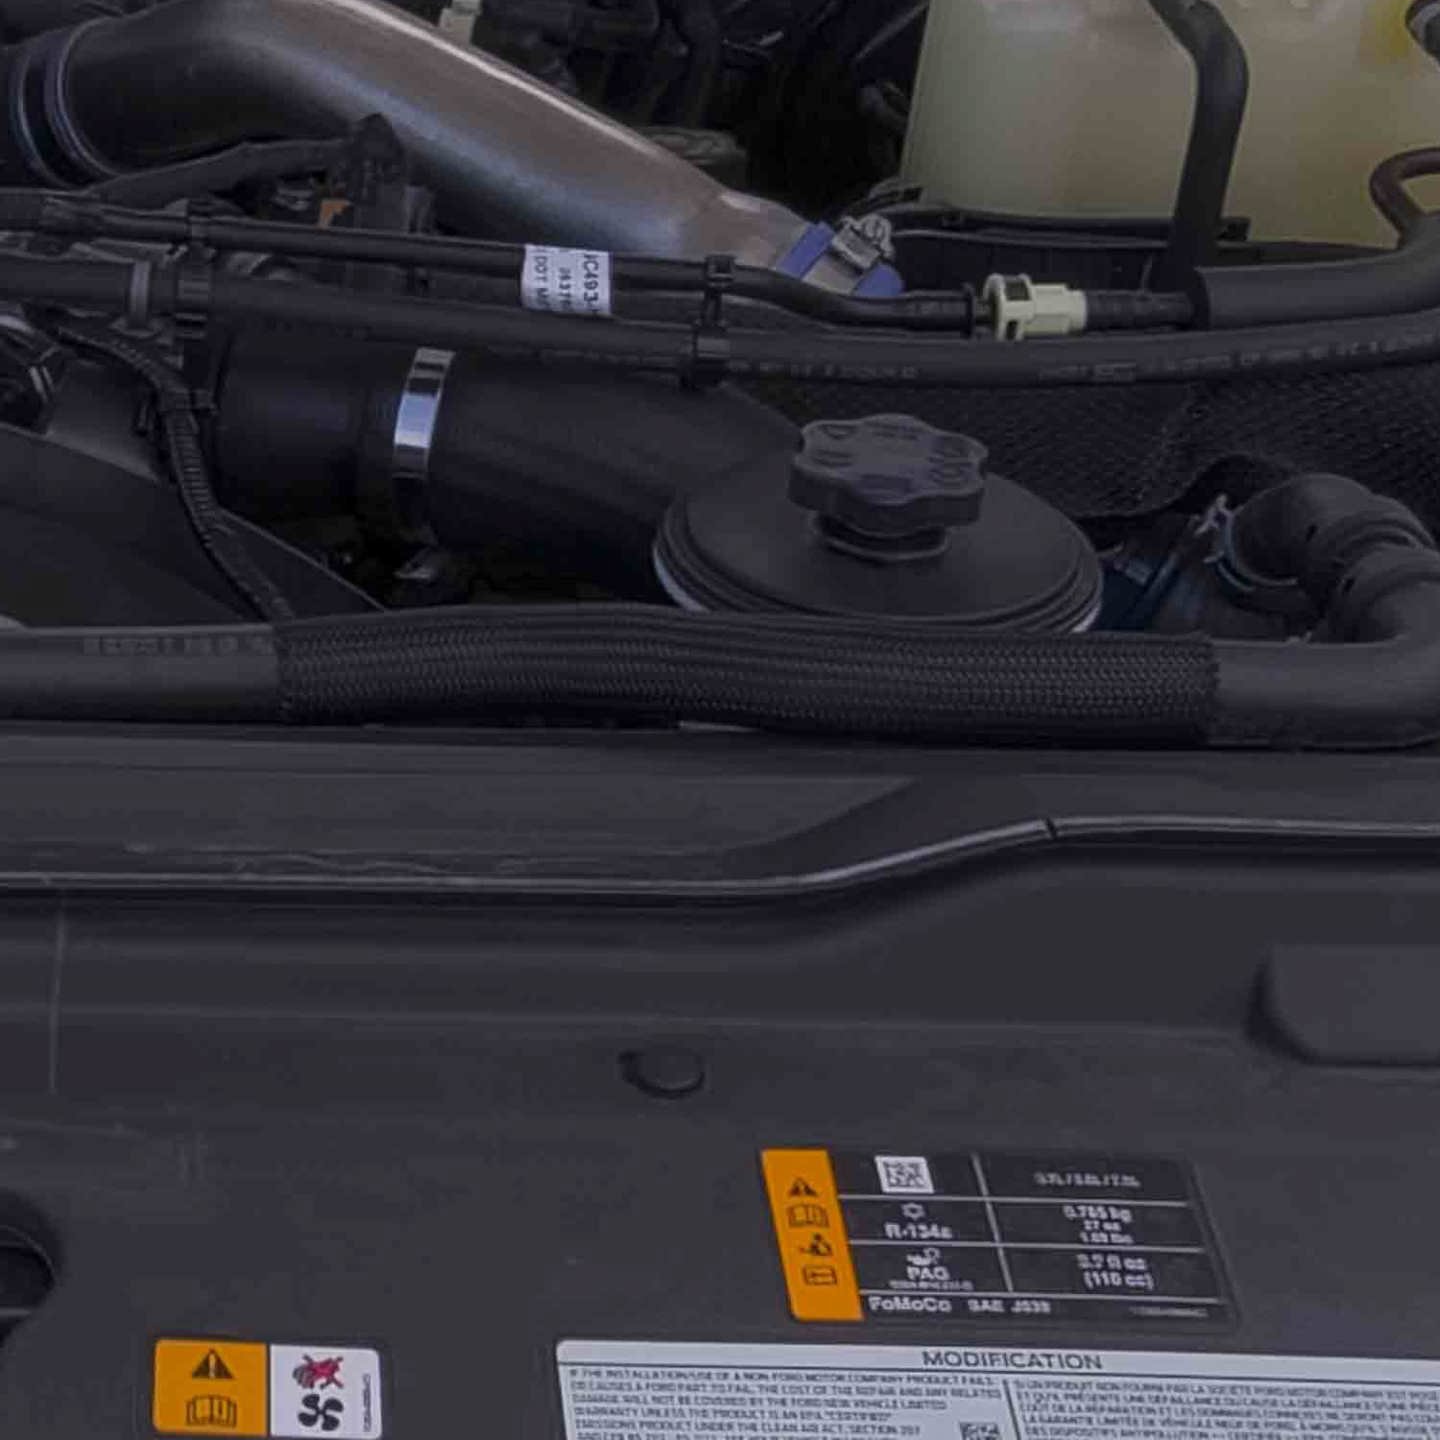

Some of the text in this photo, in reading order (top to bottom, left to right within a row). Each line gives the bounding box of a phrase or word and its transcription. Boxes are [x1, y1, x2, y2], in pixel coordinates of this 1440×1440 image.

[885, 1223, 953, 1240] R-134a
[907, 1266, 950, 1281] PAG
[868, 1296, 953, 1312] FoMoCo
[921, 1350, 1104, 1371] MODIFICATION
